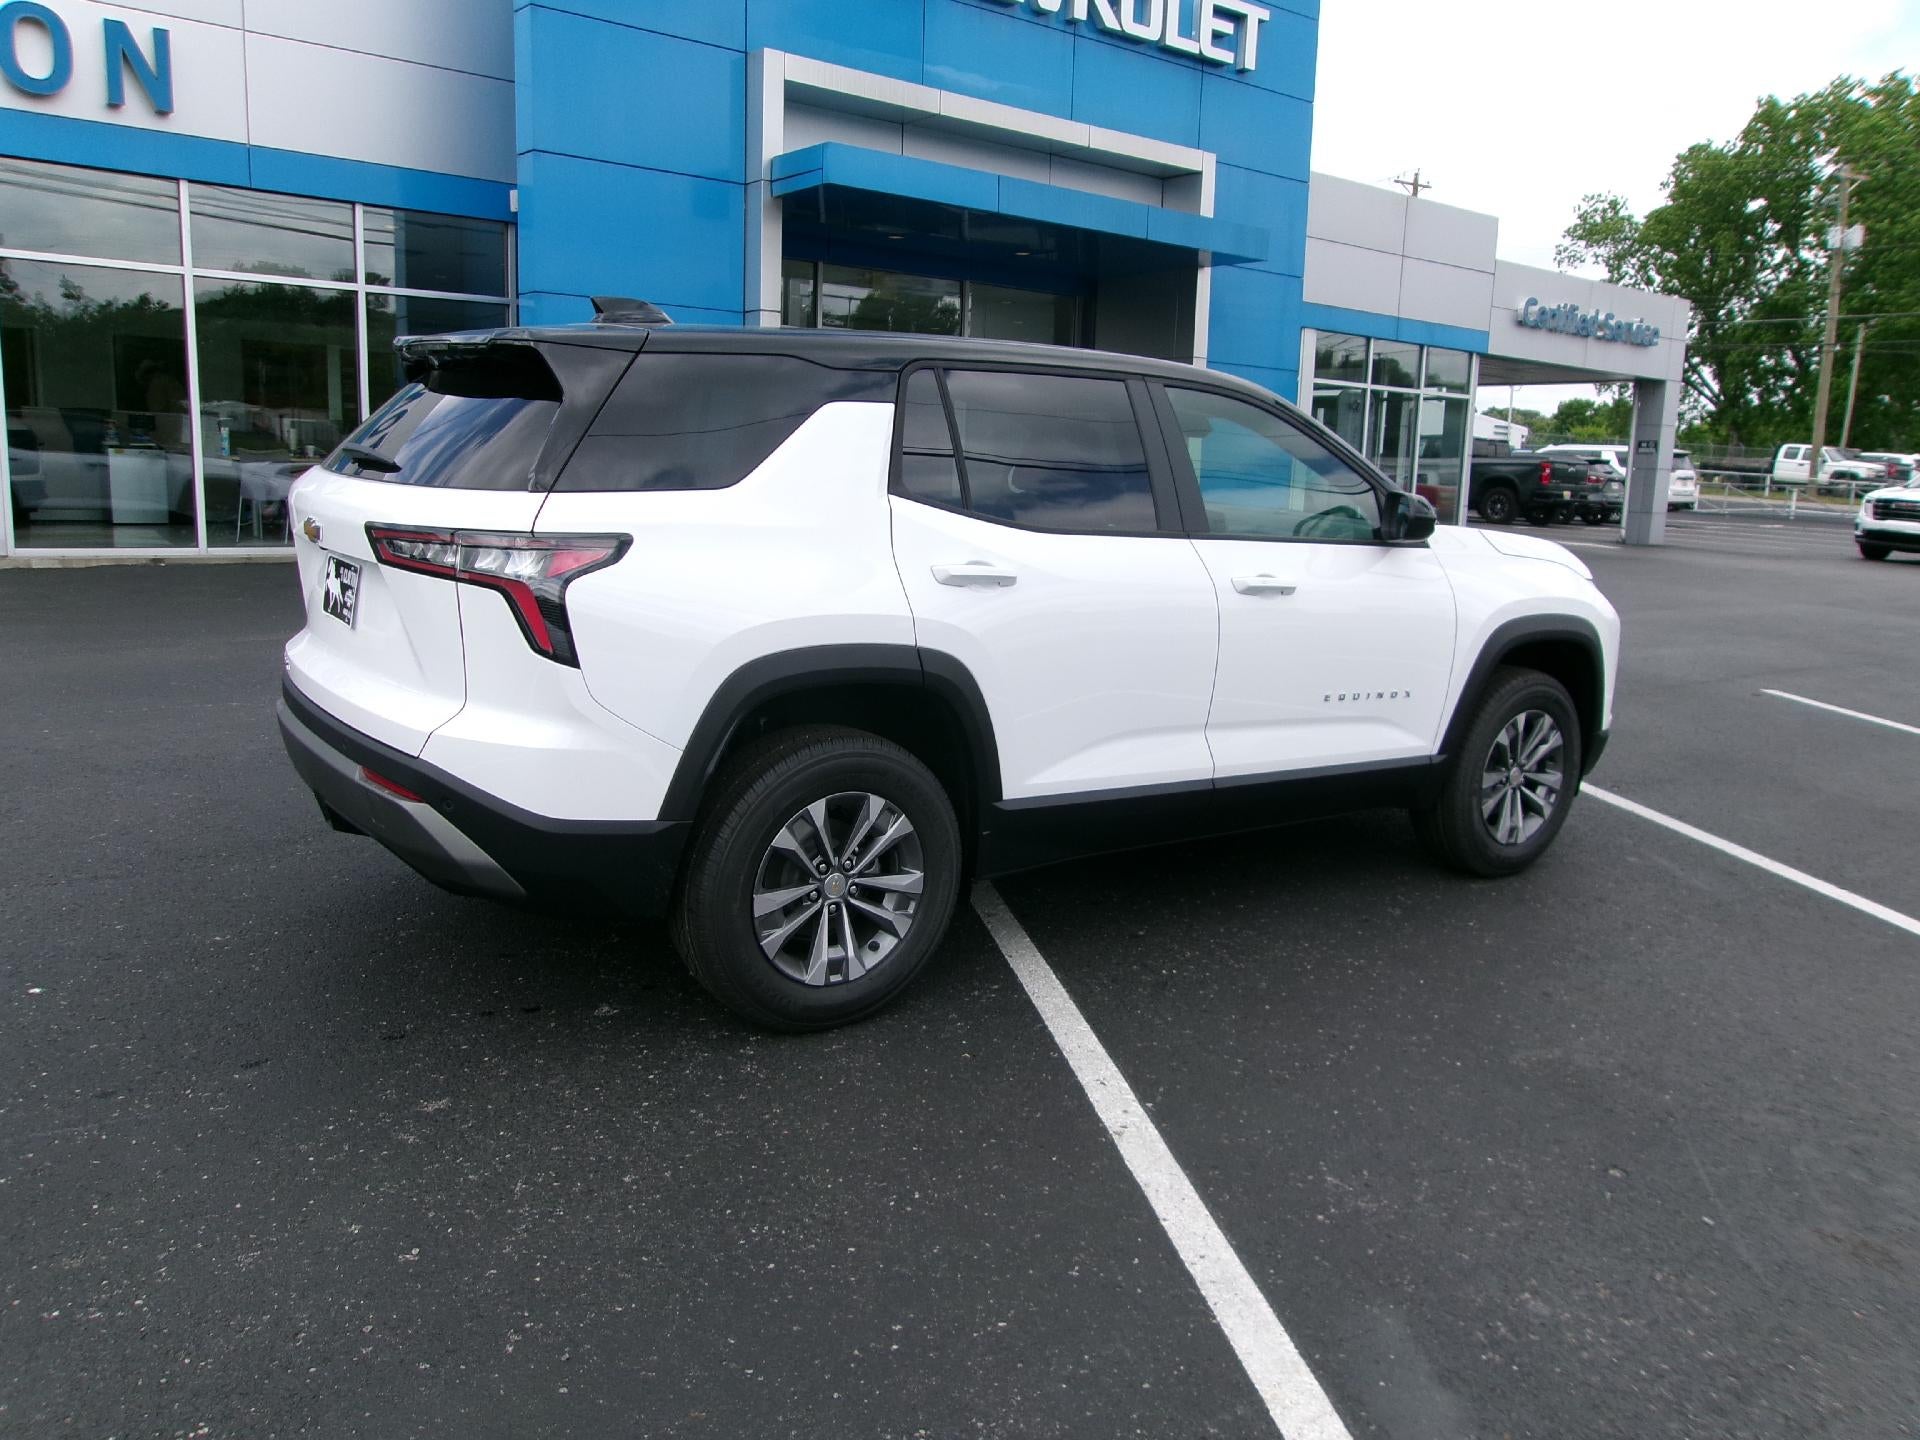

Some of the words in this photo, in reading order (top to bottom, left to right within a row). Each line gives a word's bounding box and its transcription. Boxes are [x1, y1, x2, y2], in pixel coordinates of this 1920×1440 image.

[0, 1, 174, 115] ON
[978, 0, 1271, 72] OLET
[1520, 297, 1600, 337] Certified
[1599, 312, 1661, 346] Service
[1323, 690, 1411, 702] EQUINOX
